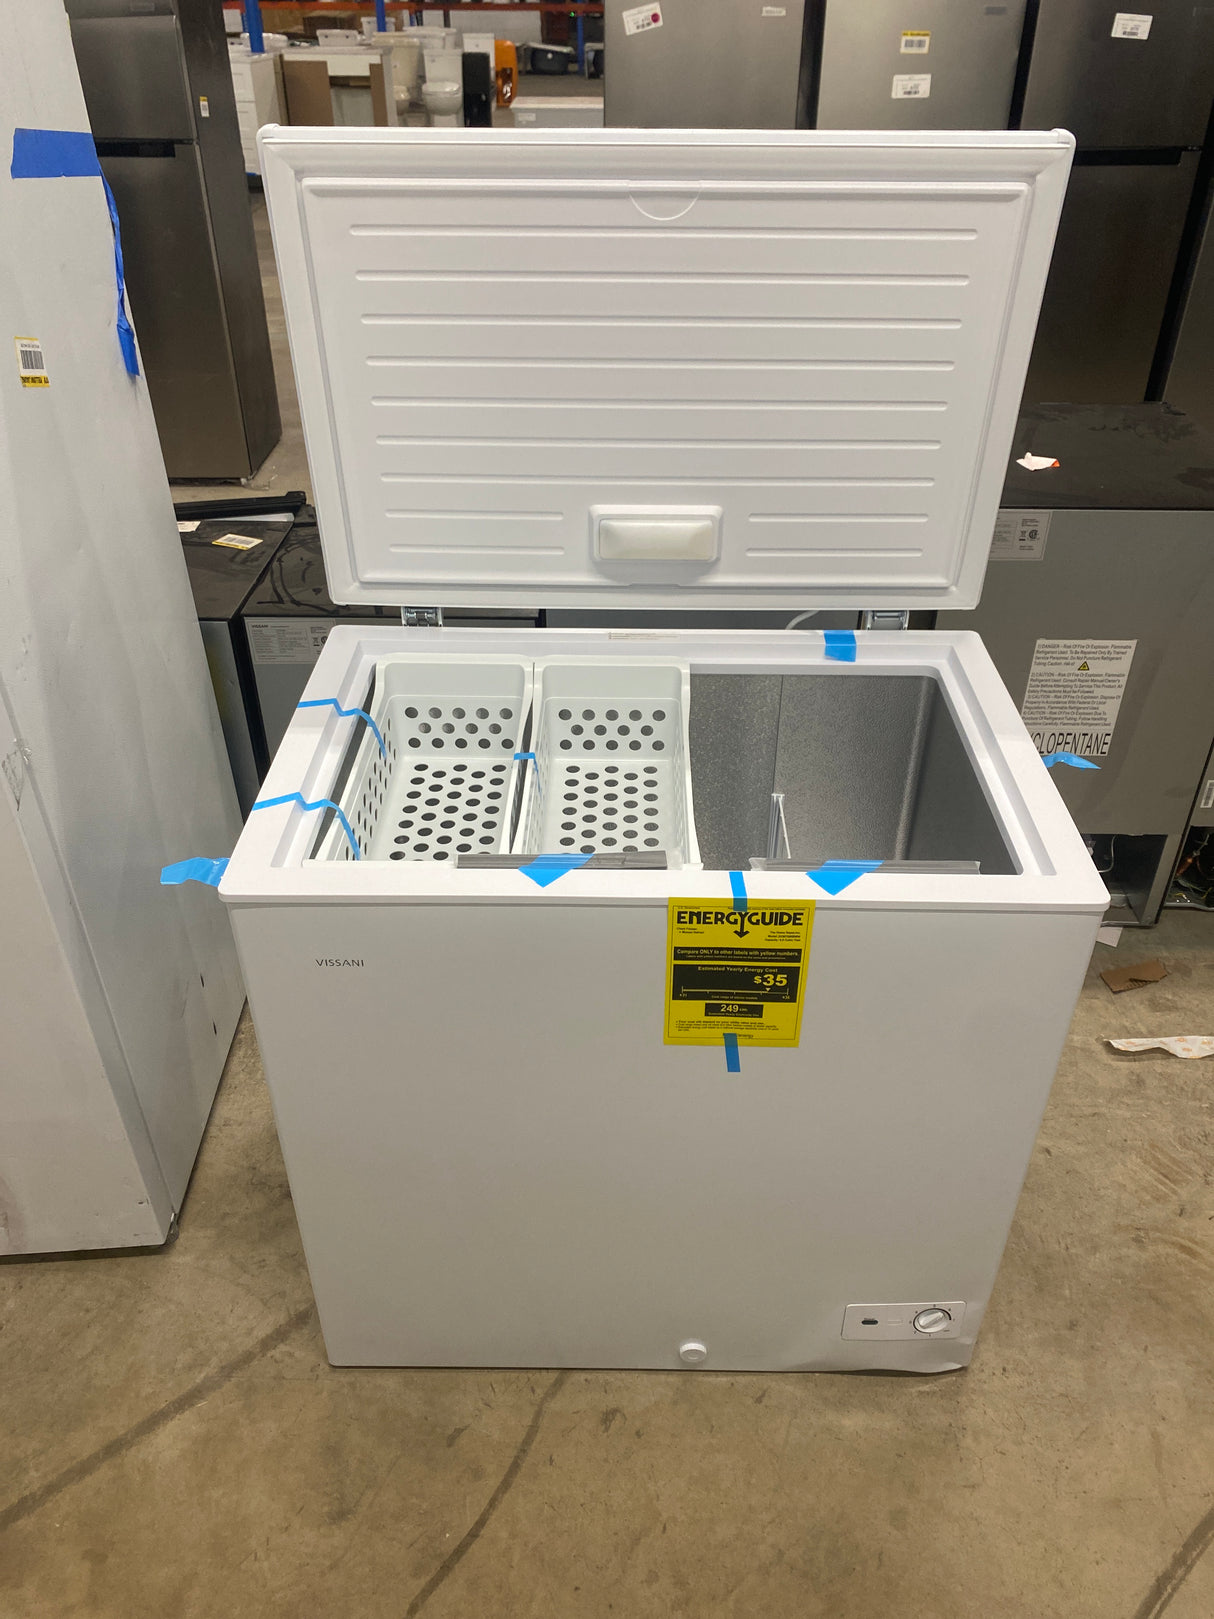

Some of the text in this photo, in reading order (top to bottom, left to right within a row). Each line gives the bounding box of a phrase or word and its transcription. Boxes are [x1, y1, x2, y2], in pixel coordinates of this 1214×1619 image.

[676, 910, 804, 926] ENERGYGUIDE
[315, 959, 364, 968] VISSANI
[753, 974, 788, 987] $35
[720, 1004, 739, 1013] 249
